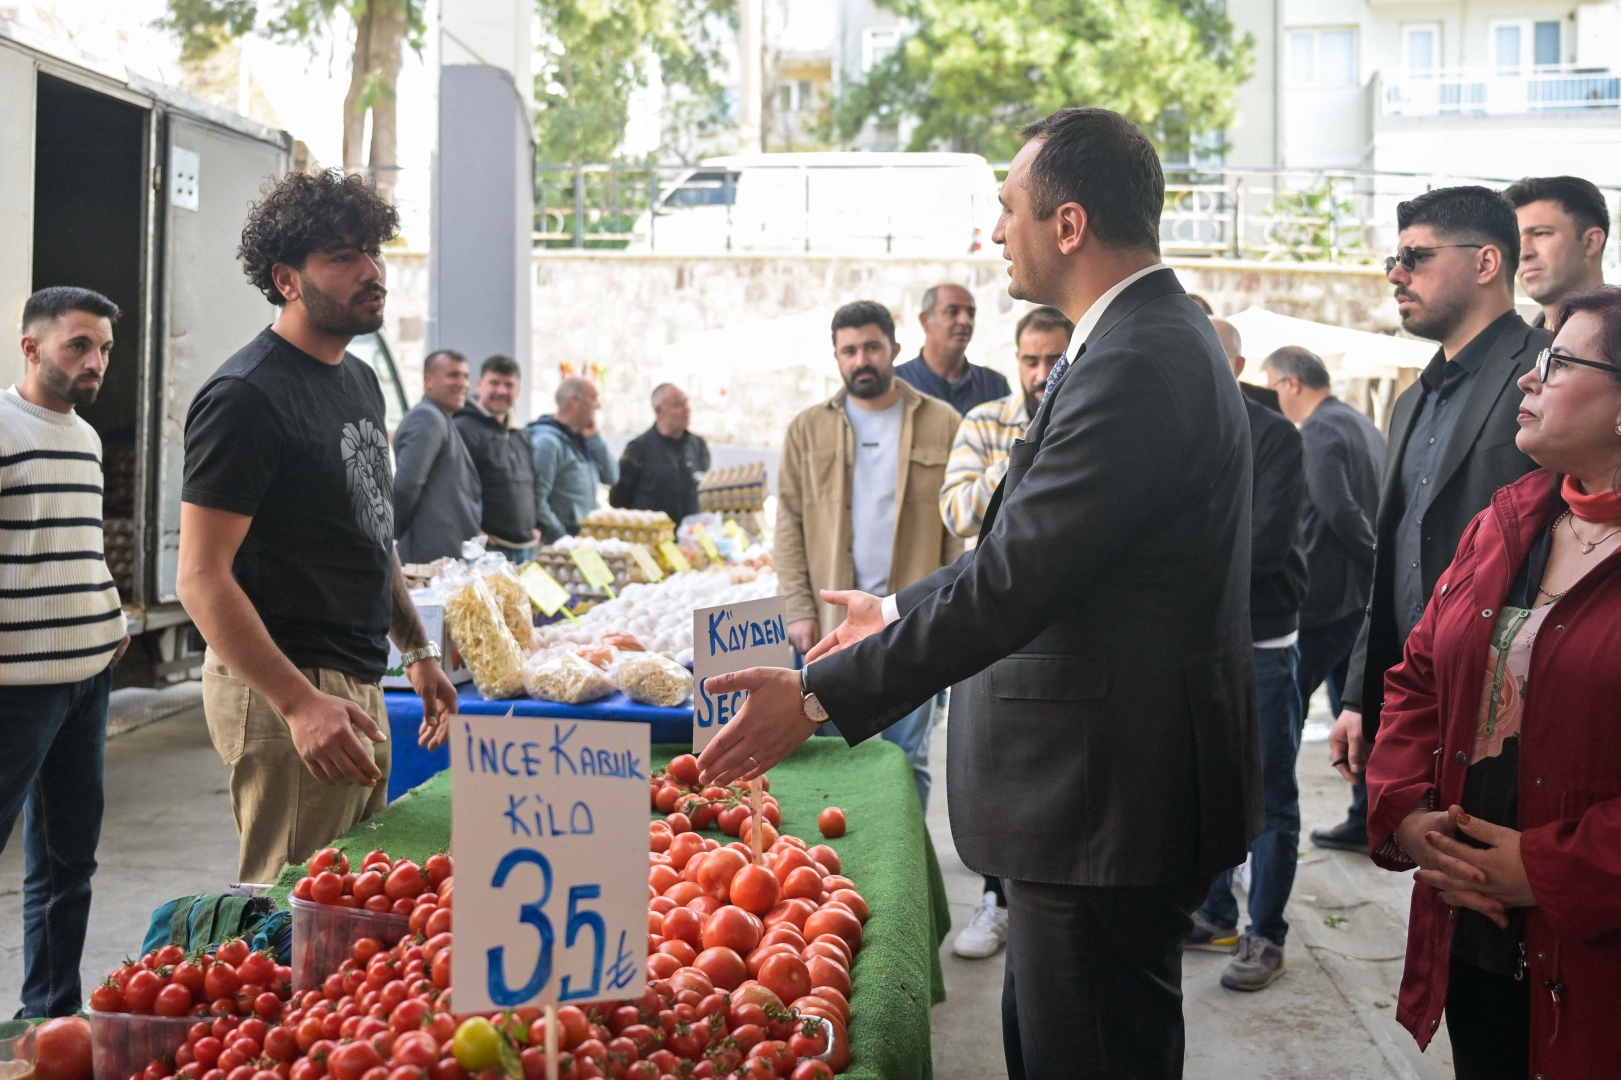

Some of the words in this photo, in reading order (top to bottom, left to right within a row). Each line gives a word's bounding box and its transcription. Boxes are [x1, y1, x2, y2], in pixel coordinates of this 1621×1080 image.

[708, 610, 785, 656] KÖYDEN
[697, 677, 750, 728] SEC
[465, 722, 541, 776] İNCE
[549, 723, 646, 779] KABUK
